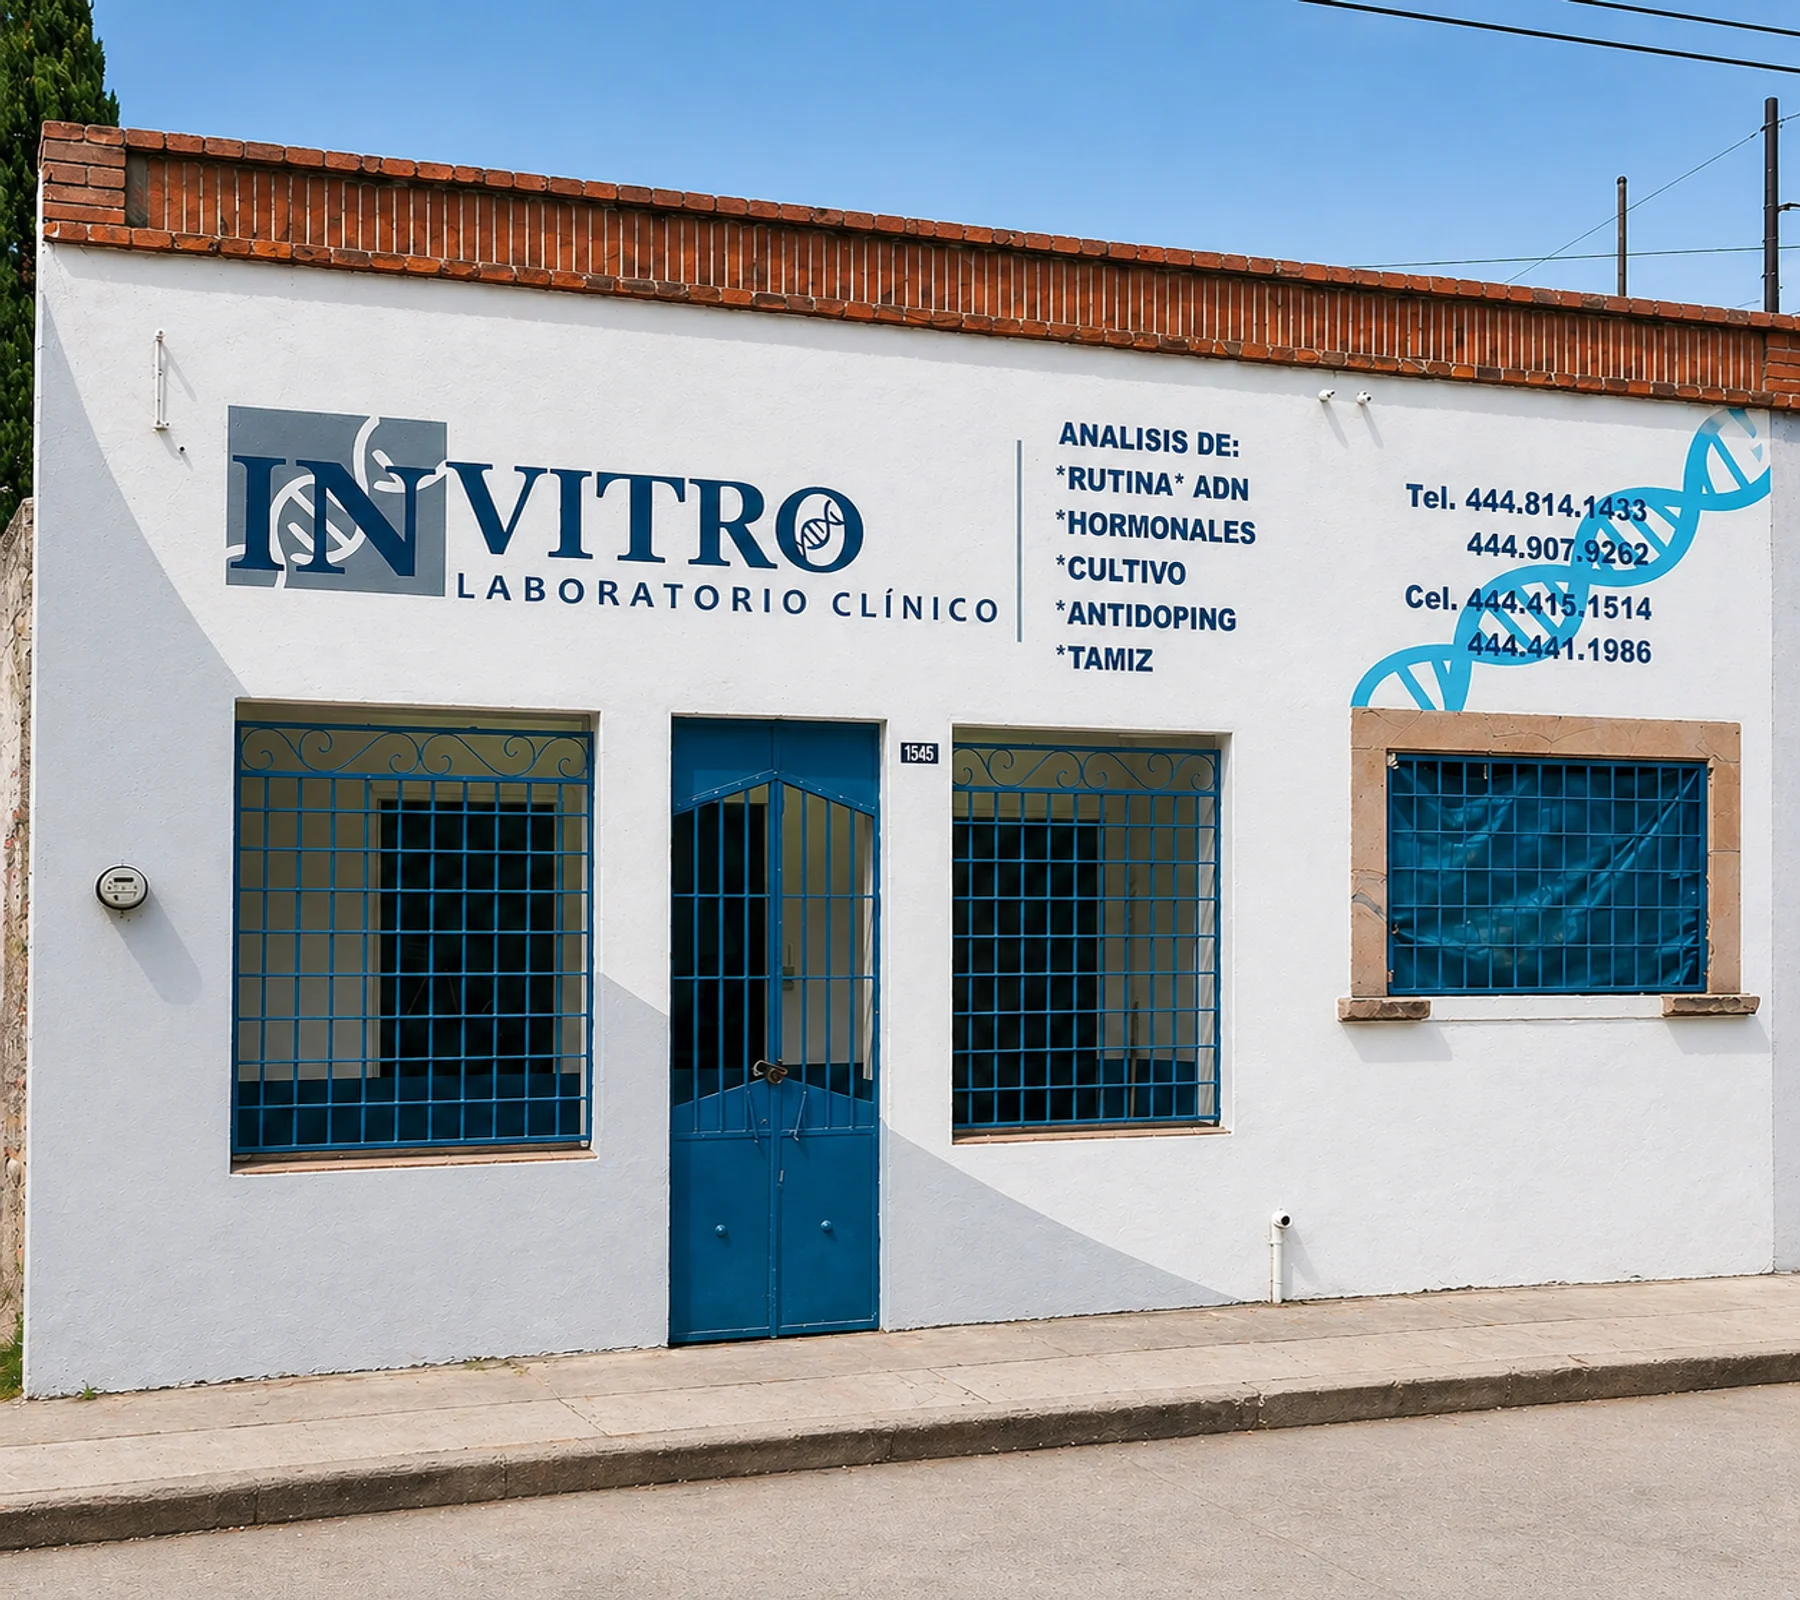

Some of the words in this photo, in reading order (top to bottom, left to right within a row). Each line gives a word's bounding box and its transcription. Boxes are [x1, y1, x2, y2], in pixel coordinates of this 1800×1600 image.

[1059, 421, 1188, 454] ANALISIS
[1197, 431, 1240, 458] DE:
[1192, 475, 1250, 502] ADN
[1406, 483, 1456, 510] Tel.
[1465, 487, 1648, 522] 444.814.1433
[1467, 532, 1650, 566] 444.907.9262
[457, 572, 809, 615] LABORATORIO
[832, 588, 999, 624] CLÍNICO
[1405, 584, 1458, 611] Cel.
[1466, 588, 1653, 621] 444.415.1514
[1467, 631, 1652, 664] 444.441.1986
[904, 744, 935, 762] 1545
